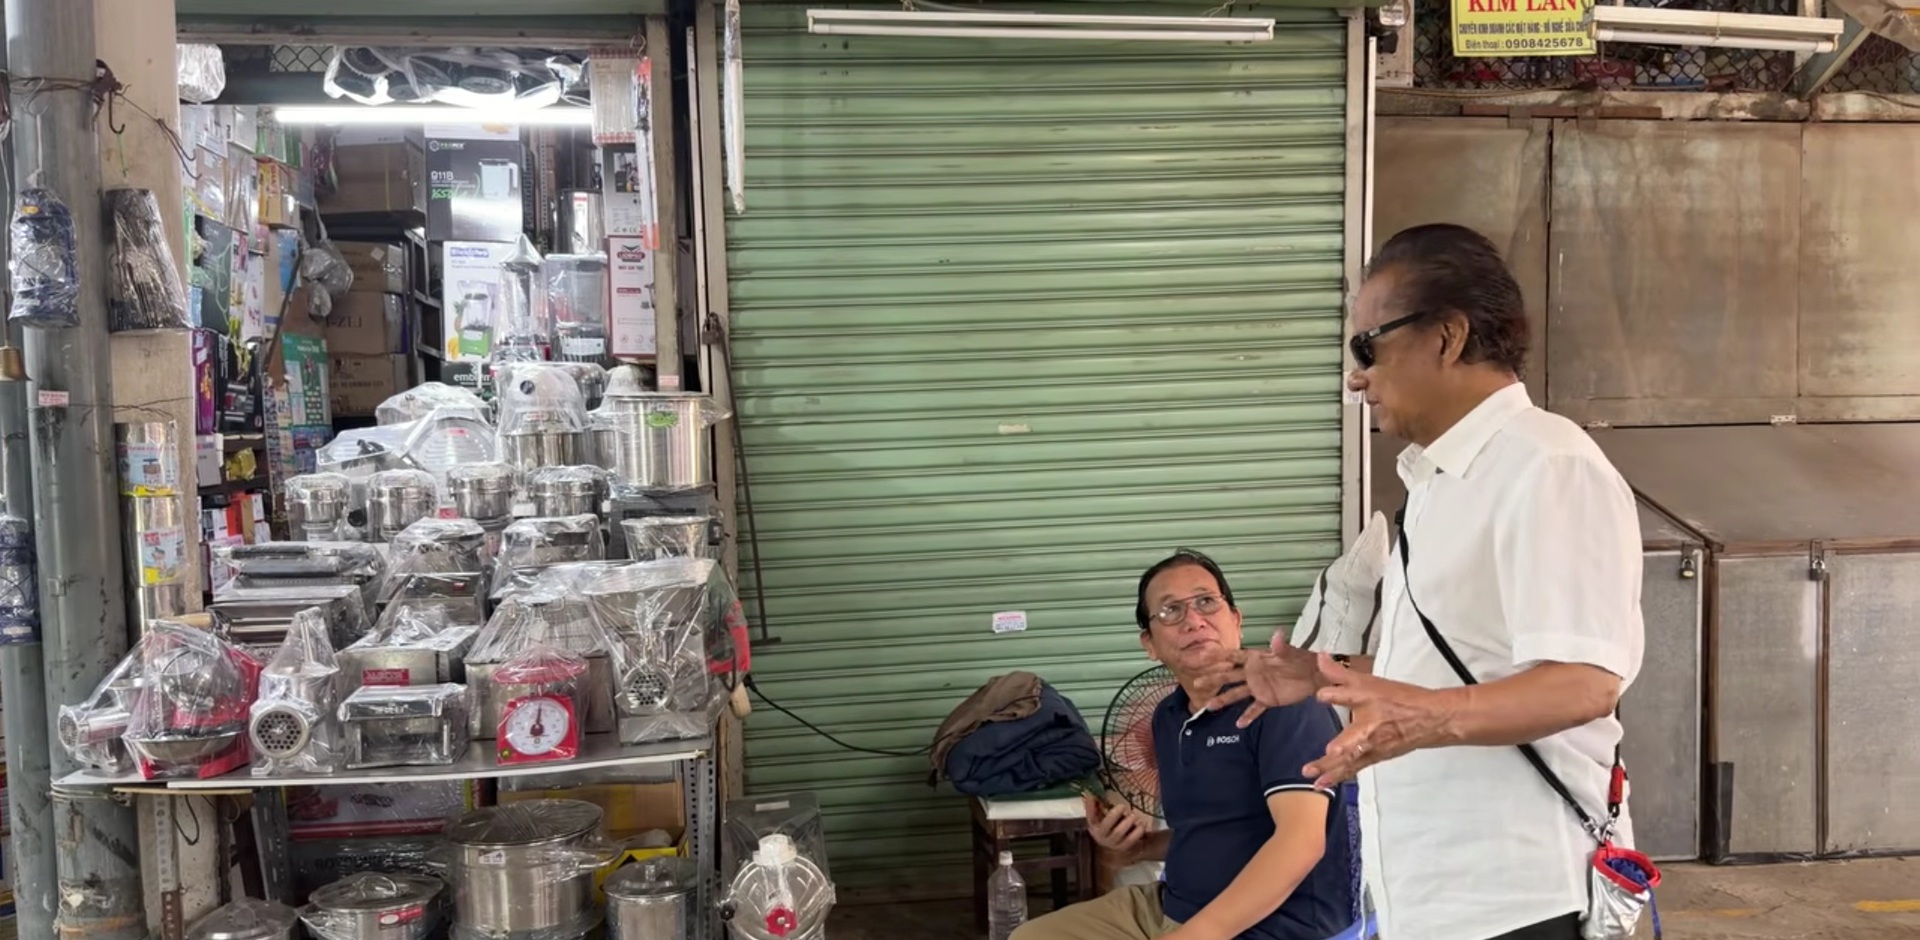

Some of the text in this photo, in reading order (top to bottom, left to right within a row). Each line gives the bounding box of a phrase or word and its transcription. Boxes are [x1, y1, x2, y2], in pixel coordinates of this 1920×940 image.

[1468, 0, 1576, 12] KIM LAN
[1505, 37, 1584, 49] 0908425678
[1216, 735, 1240, 744] BOSCH
